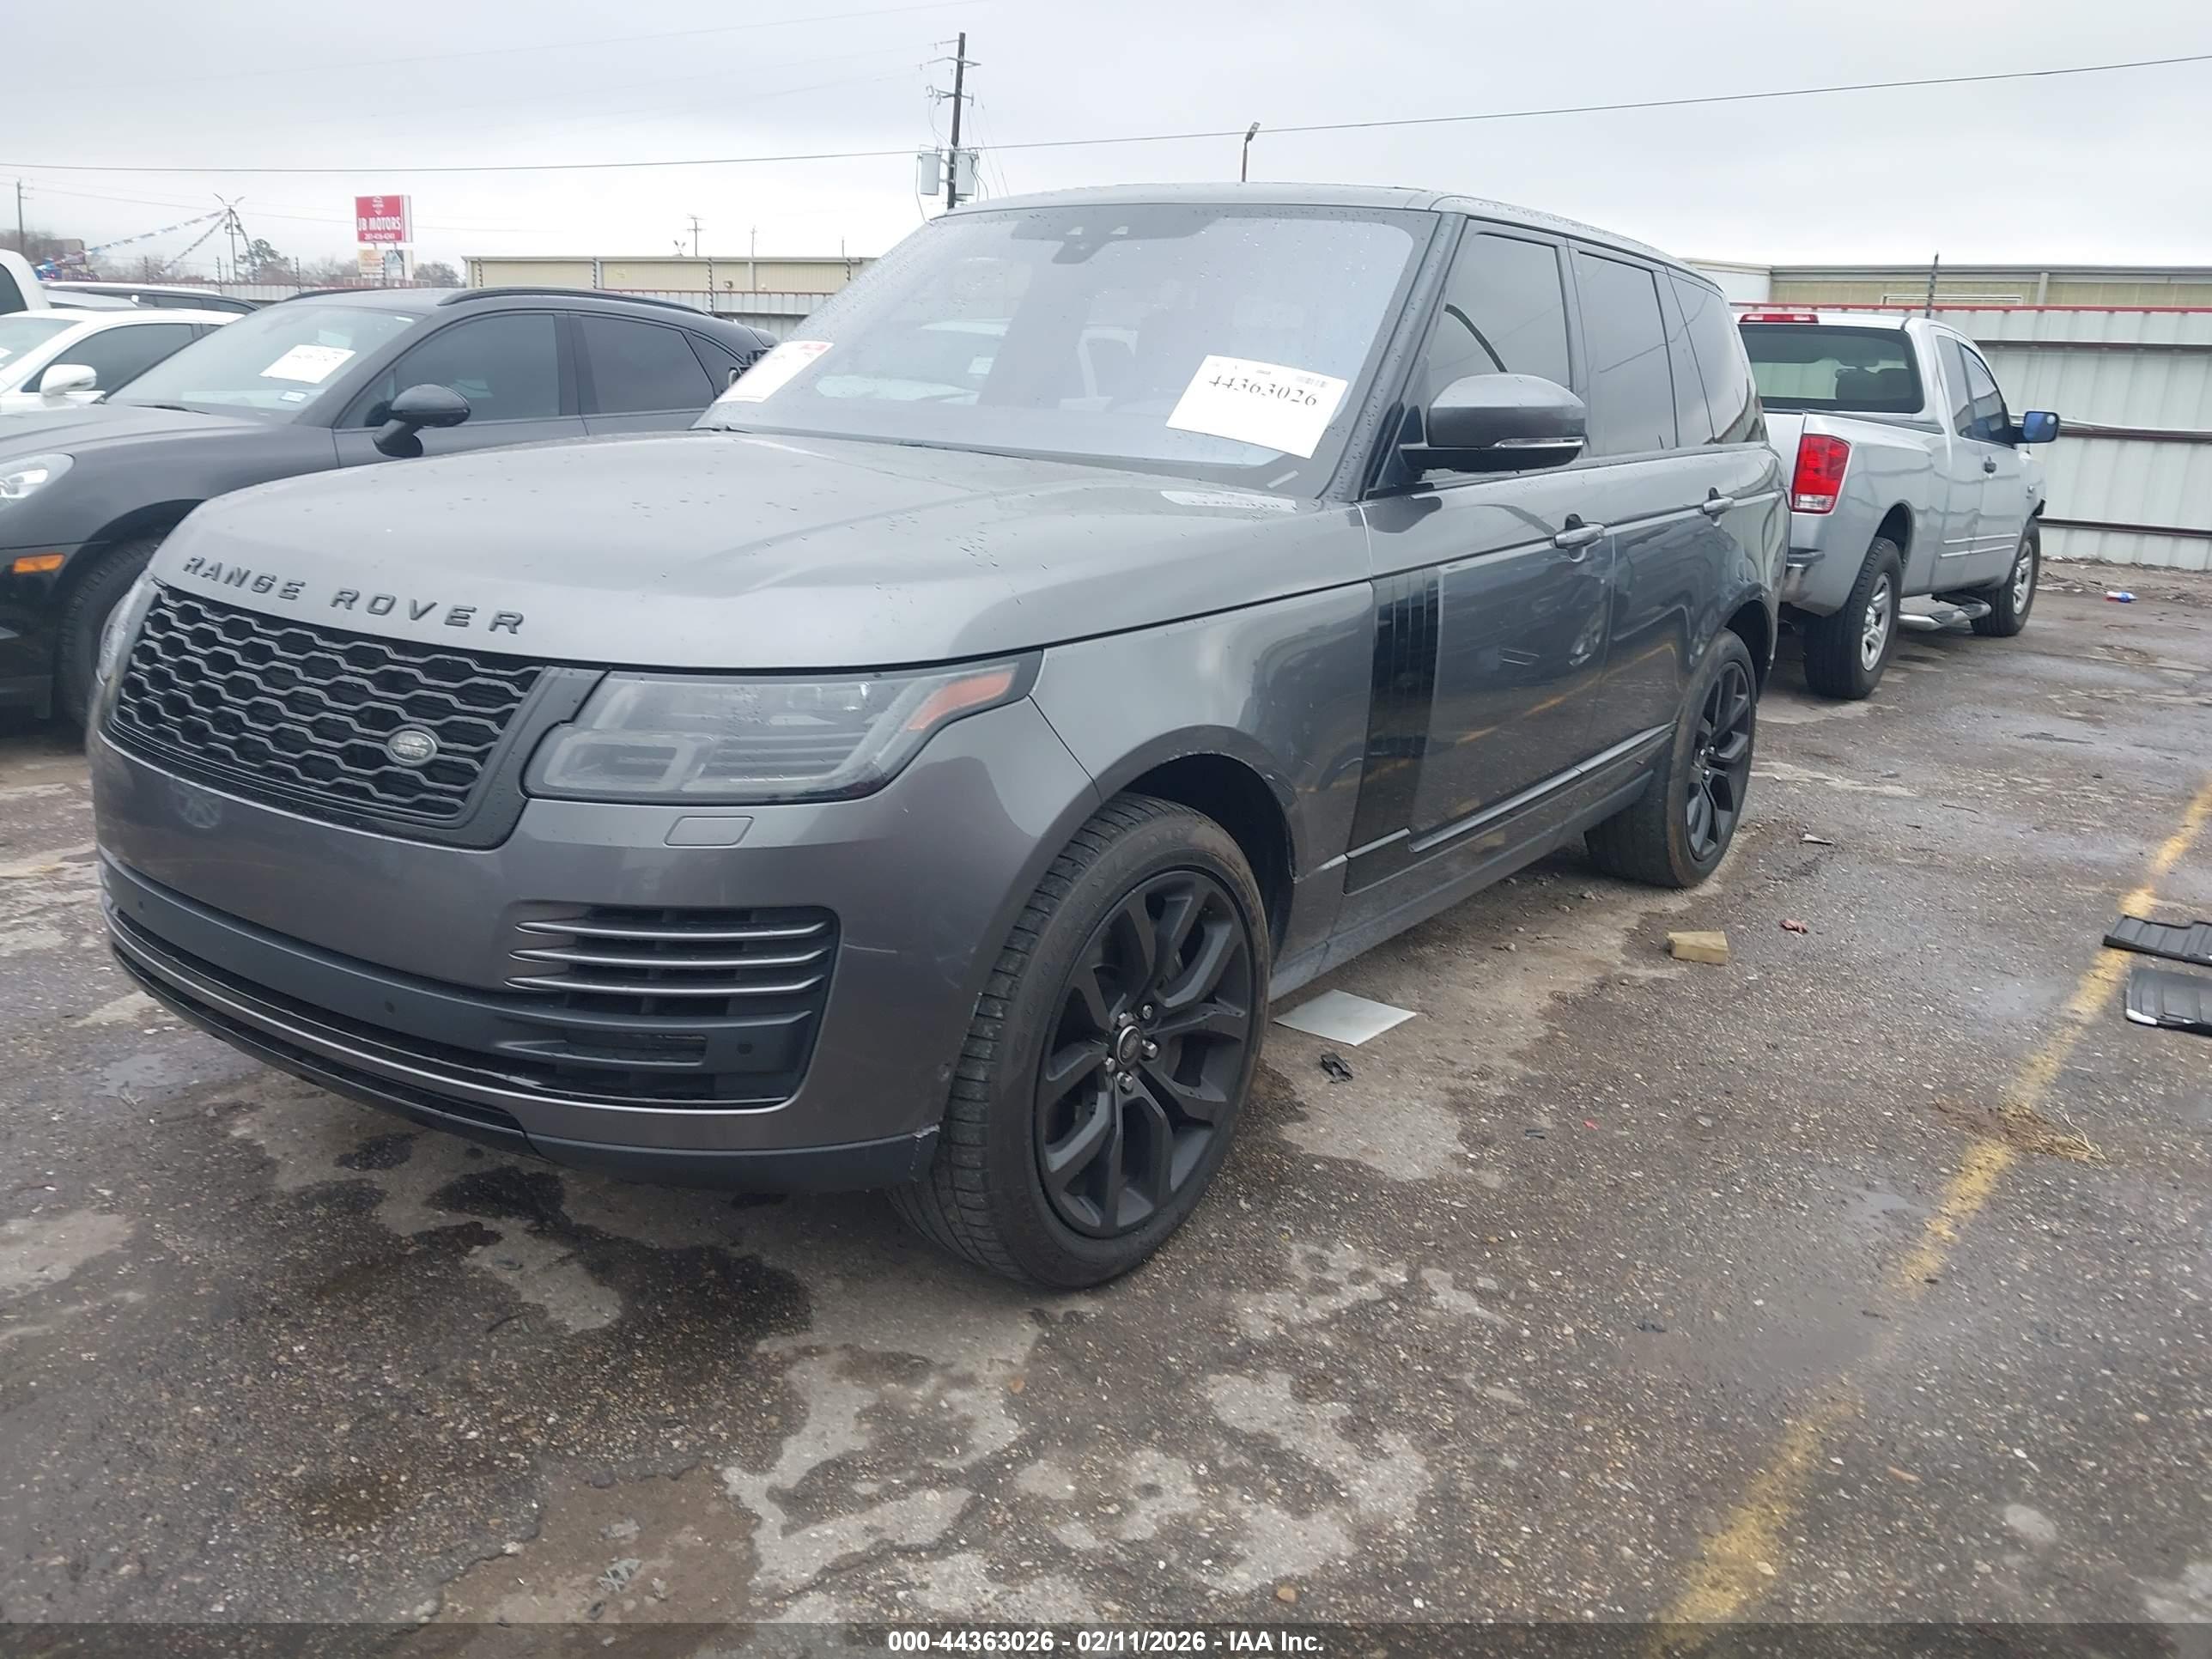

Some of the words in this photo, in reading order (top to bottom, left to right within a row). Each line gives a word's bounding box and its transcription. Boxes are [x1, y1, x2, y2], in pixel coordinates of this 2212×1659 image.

[368, 216, 401, 232] MOTORS
[1208, 374, 1318, 407] 44363026
[183, 556, 307, 601] RANGE
[330, 587, 525, 635] ROVER
